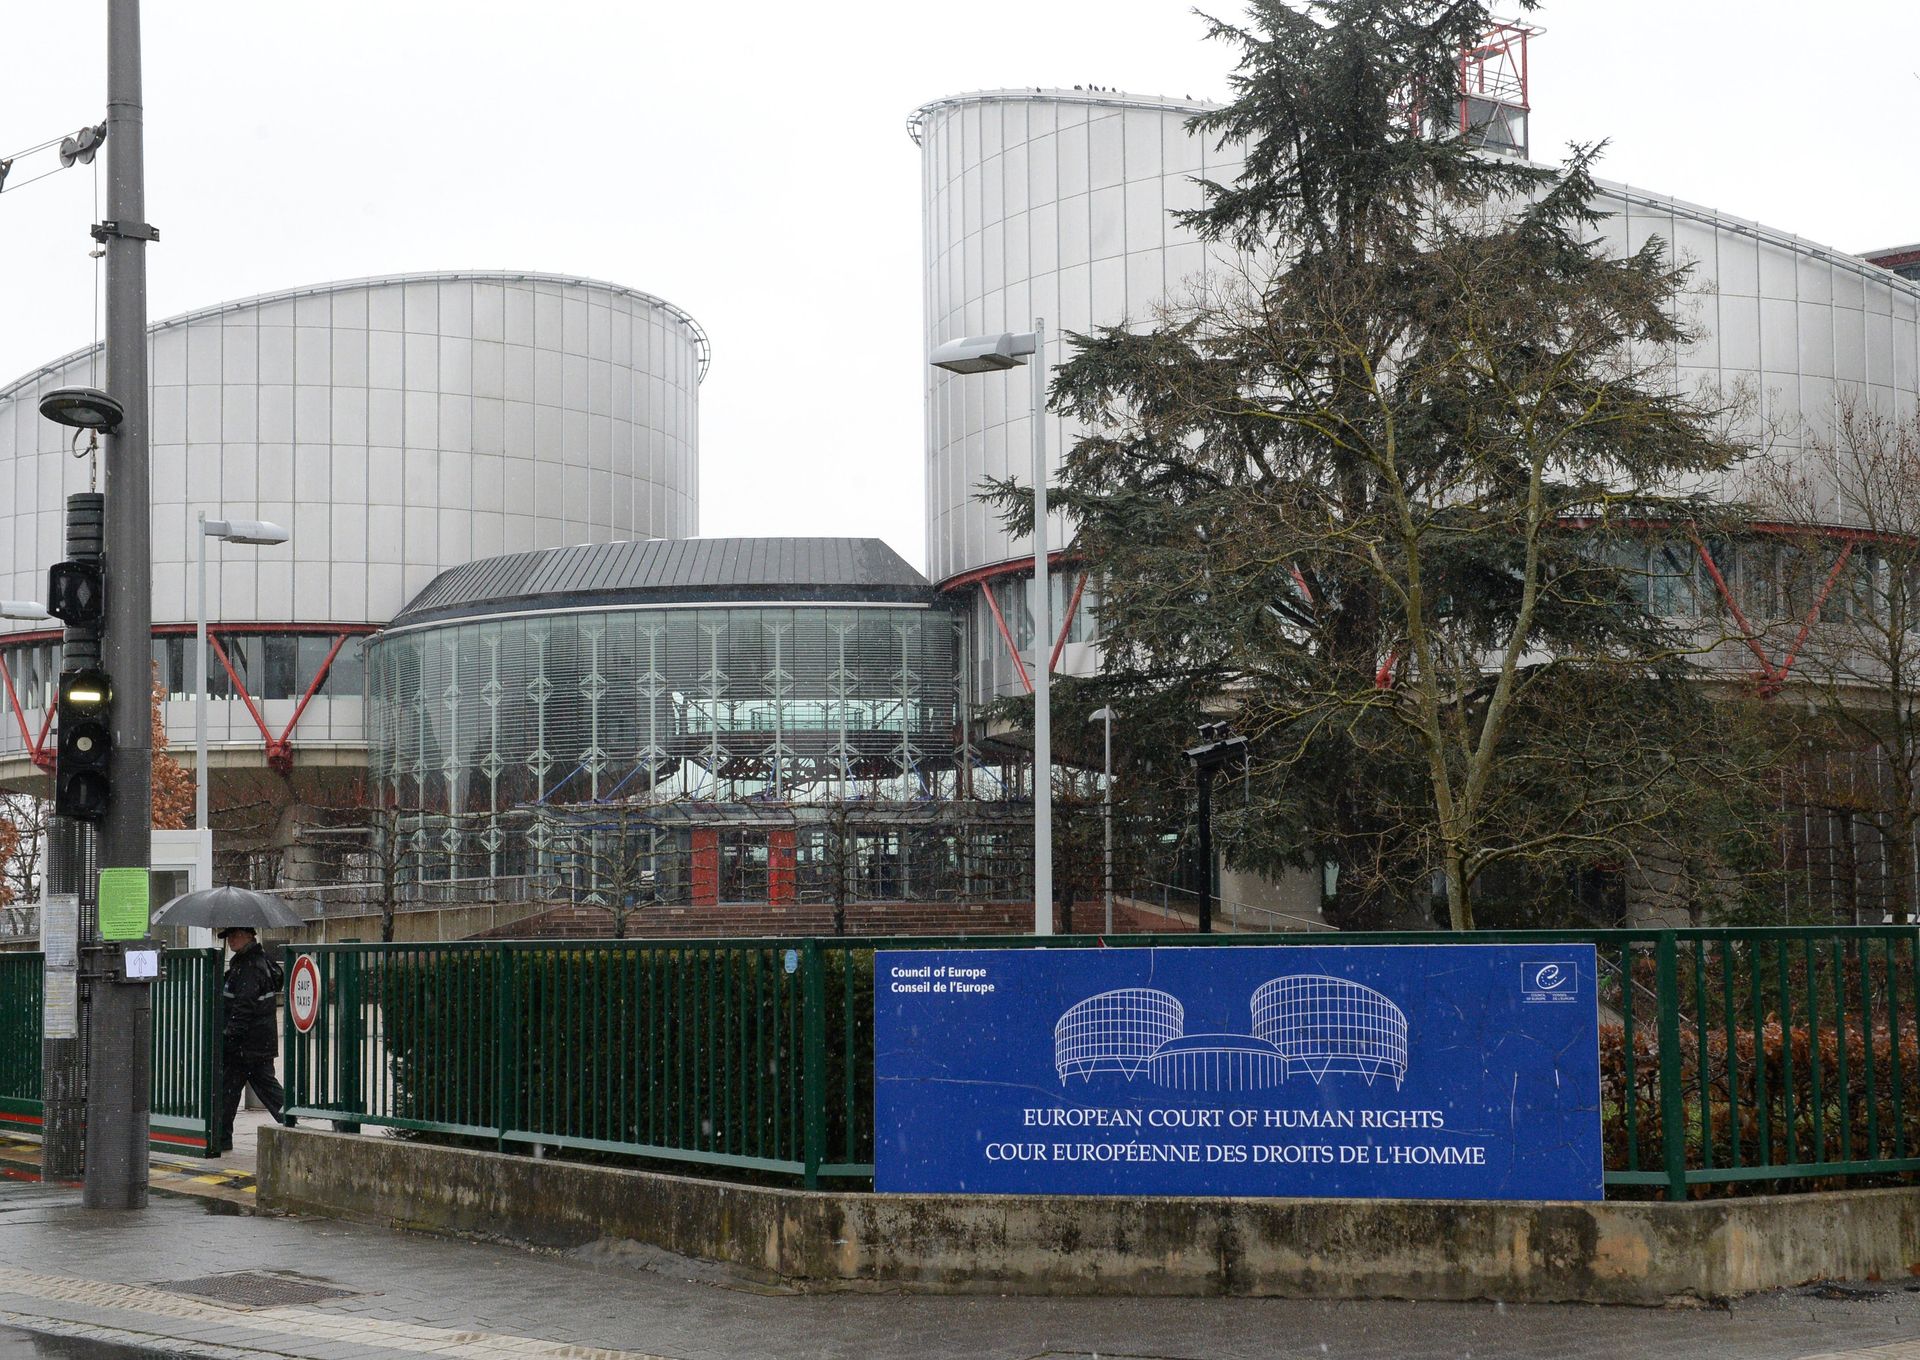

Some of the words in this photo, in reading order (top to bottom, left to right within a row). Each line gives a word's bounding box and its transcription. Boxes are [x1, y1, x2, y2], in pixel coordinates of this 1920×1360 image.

[891, 966, 931, 978] Council
[933, 966, 946, 978] of
[948, 966, 987, 980] Europe
[297, 980, 310, 991] SAUF
[891, 981, 931, 993] Conseil
[933, 981, 947, 993] de
[949, 981, 995, 995] l'Europe
[297, 996, 311, 1007] TAXIS
[1024, 1108, 1143, 1127] EUROPEAN
[1148, 1109, 1224, 1127] COURT
[1228, 1109, 1258, 1127] OF
[1263, 1110, 1355, 1128] HUMAN
[1360, 1110, 1444, 1129] RIGHTS
[985, 1143, 1047, 1161] COUR
[1052, 1139, 1200, 1162] EUROPÉENNE
[1206, 1144, 1248, 1163] DES
[1252, 1145, 1334, 1163] DROITS
[1339, 1145, 1370, 1164] DE
[1375, 1146, 1486, 1165] L'HOMME
